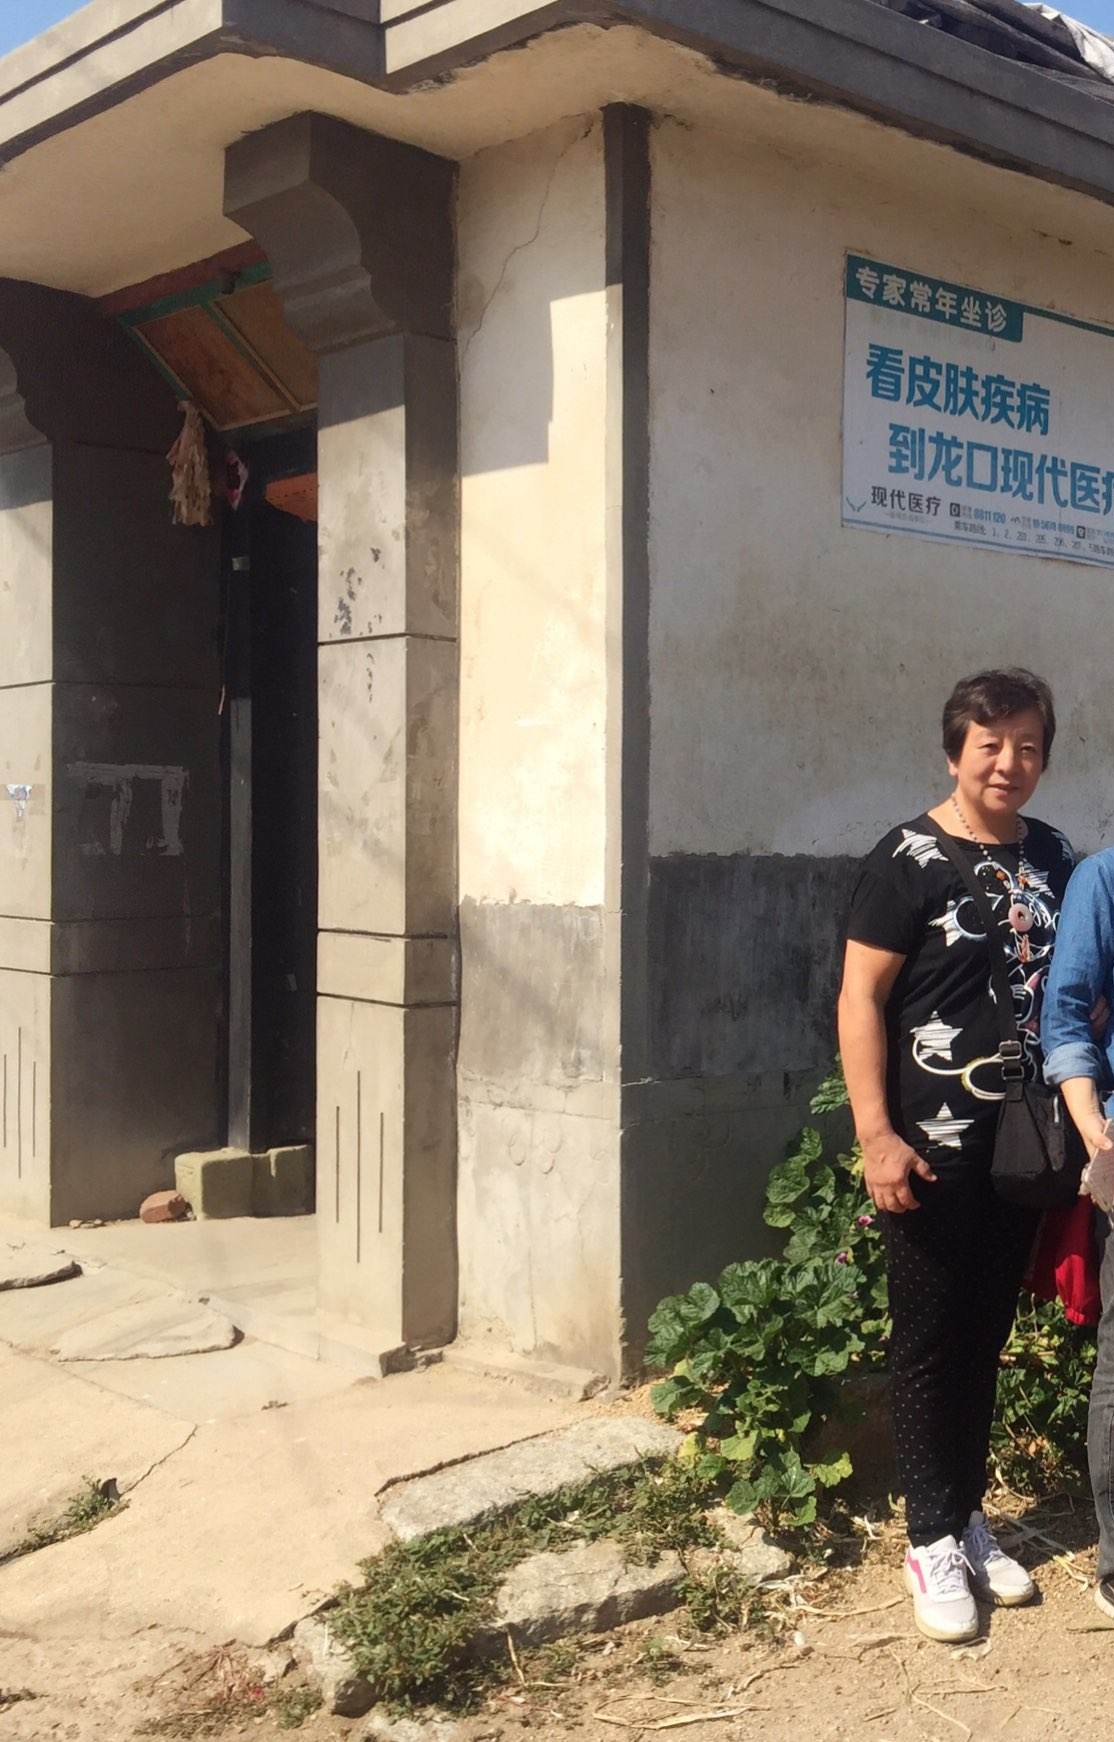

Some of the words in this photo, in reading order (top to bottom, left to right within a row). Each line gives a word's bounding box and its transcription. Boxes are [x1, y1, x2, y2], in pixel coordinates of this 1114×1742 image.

[855, 265, 1008, 334] 专家常年坐诊
[865, 343, 1051, 436] 看皮肤疾病
[871, 485, 942, 517] 现代医疗
